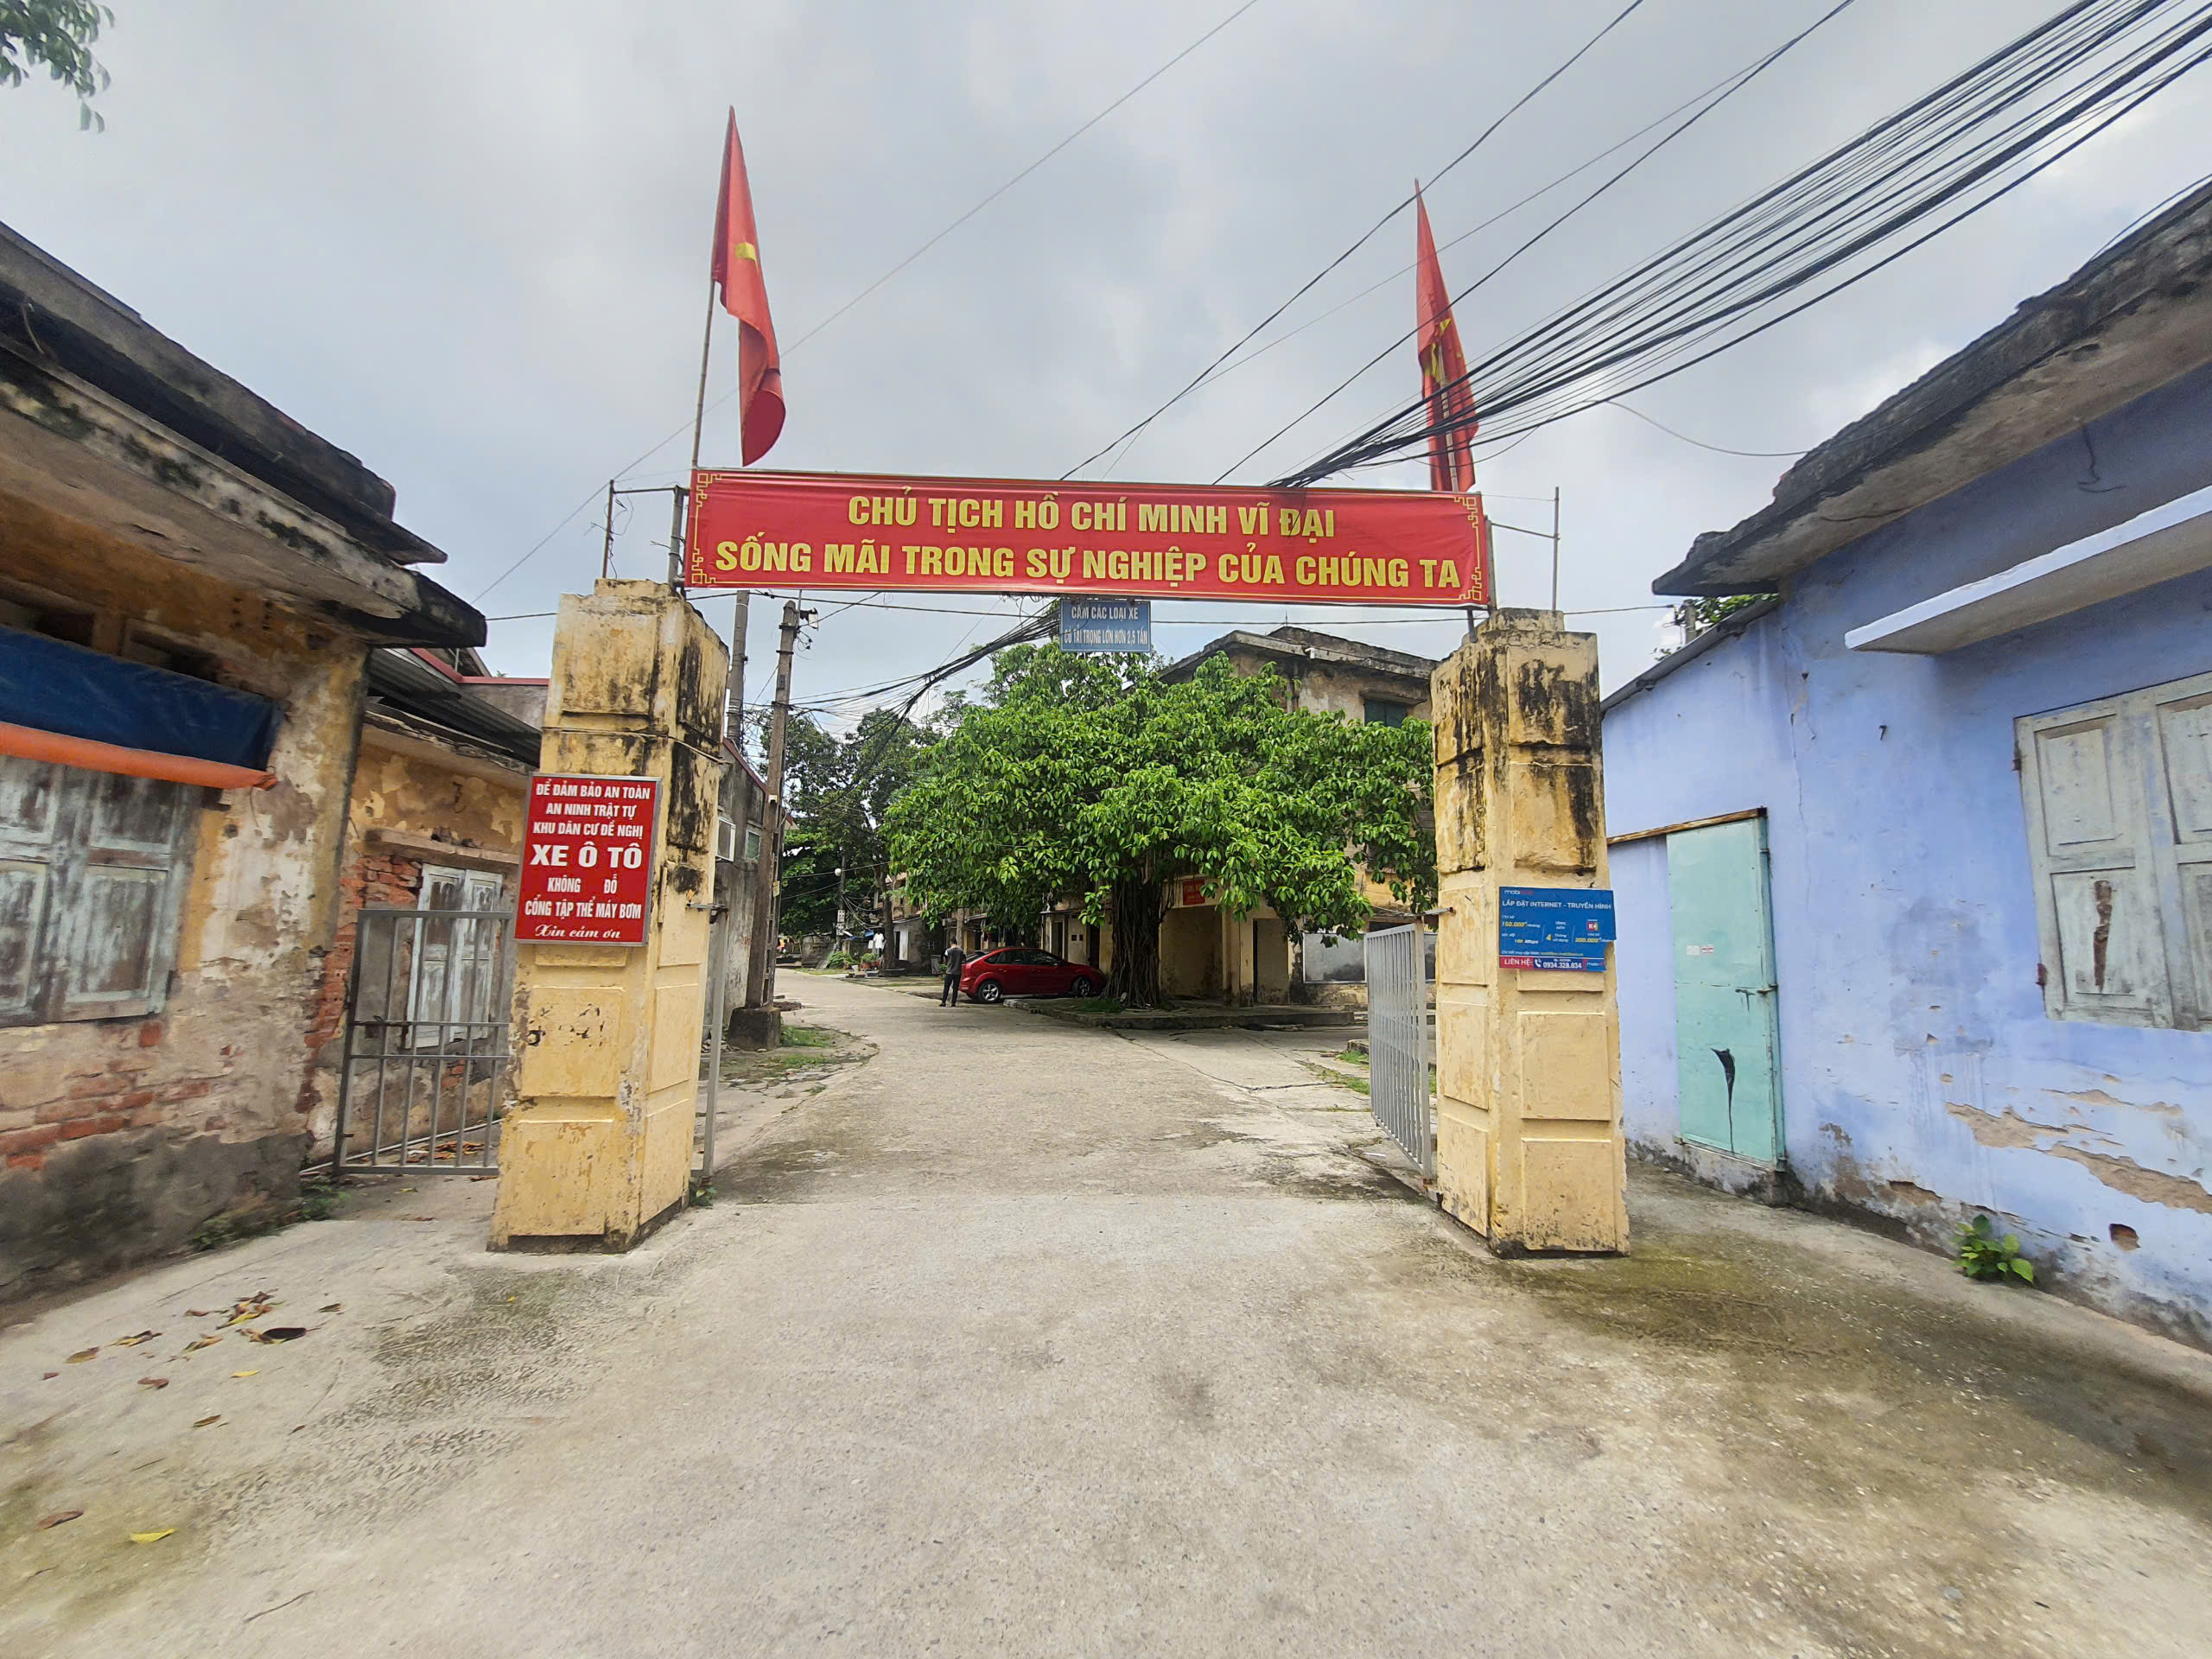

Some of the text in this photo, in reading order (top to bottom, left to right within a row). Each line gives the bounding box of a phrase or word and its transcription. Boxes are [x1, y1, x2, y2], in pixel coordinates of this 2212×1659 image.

[849, 486, 1335, 544] CHỦ TỊCH HỒ CHÍ MINH VĨ ĐẠI
[715, 531, 1461, 588] SỐNG MÃI TRONG SỰ NGHIỆP CỦA CHÚNG TA
[1109, 607, 1127, 622] LOẠI
[1128, 607, 1139, 620] XE
[536, 779, 651, 799] ĐỂ ĐẢM BẢO AN TOÀN
[546, 802, 637, 820] AN NINH TRẬT TỰ
[532, 822, 556, 834] KHU
[557, 820, 582, 836] DÂN
[583, 823, 601, 836] CƯ
[616, 824, 644, 839] NGHỊ
[530, 841, 643, 869] XE Ô TÔ
[547, 874, 582, 893] KHÔNG
[524, 893, 642, 920] CỔNG TẬP THỂ MÁY BƠM
[535, 924, 566, 938] Xin
